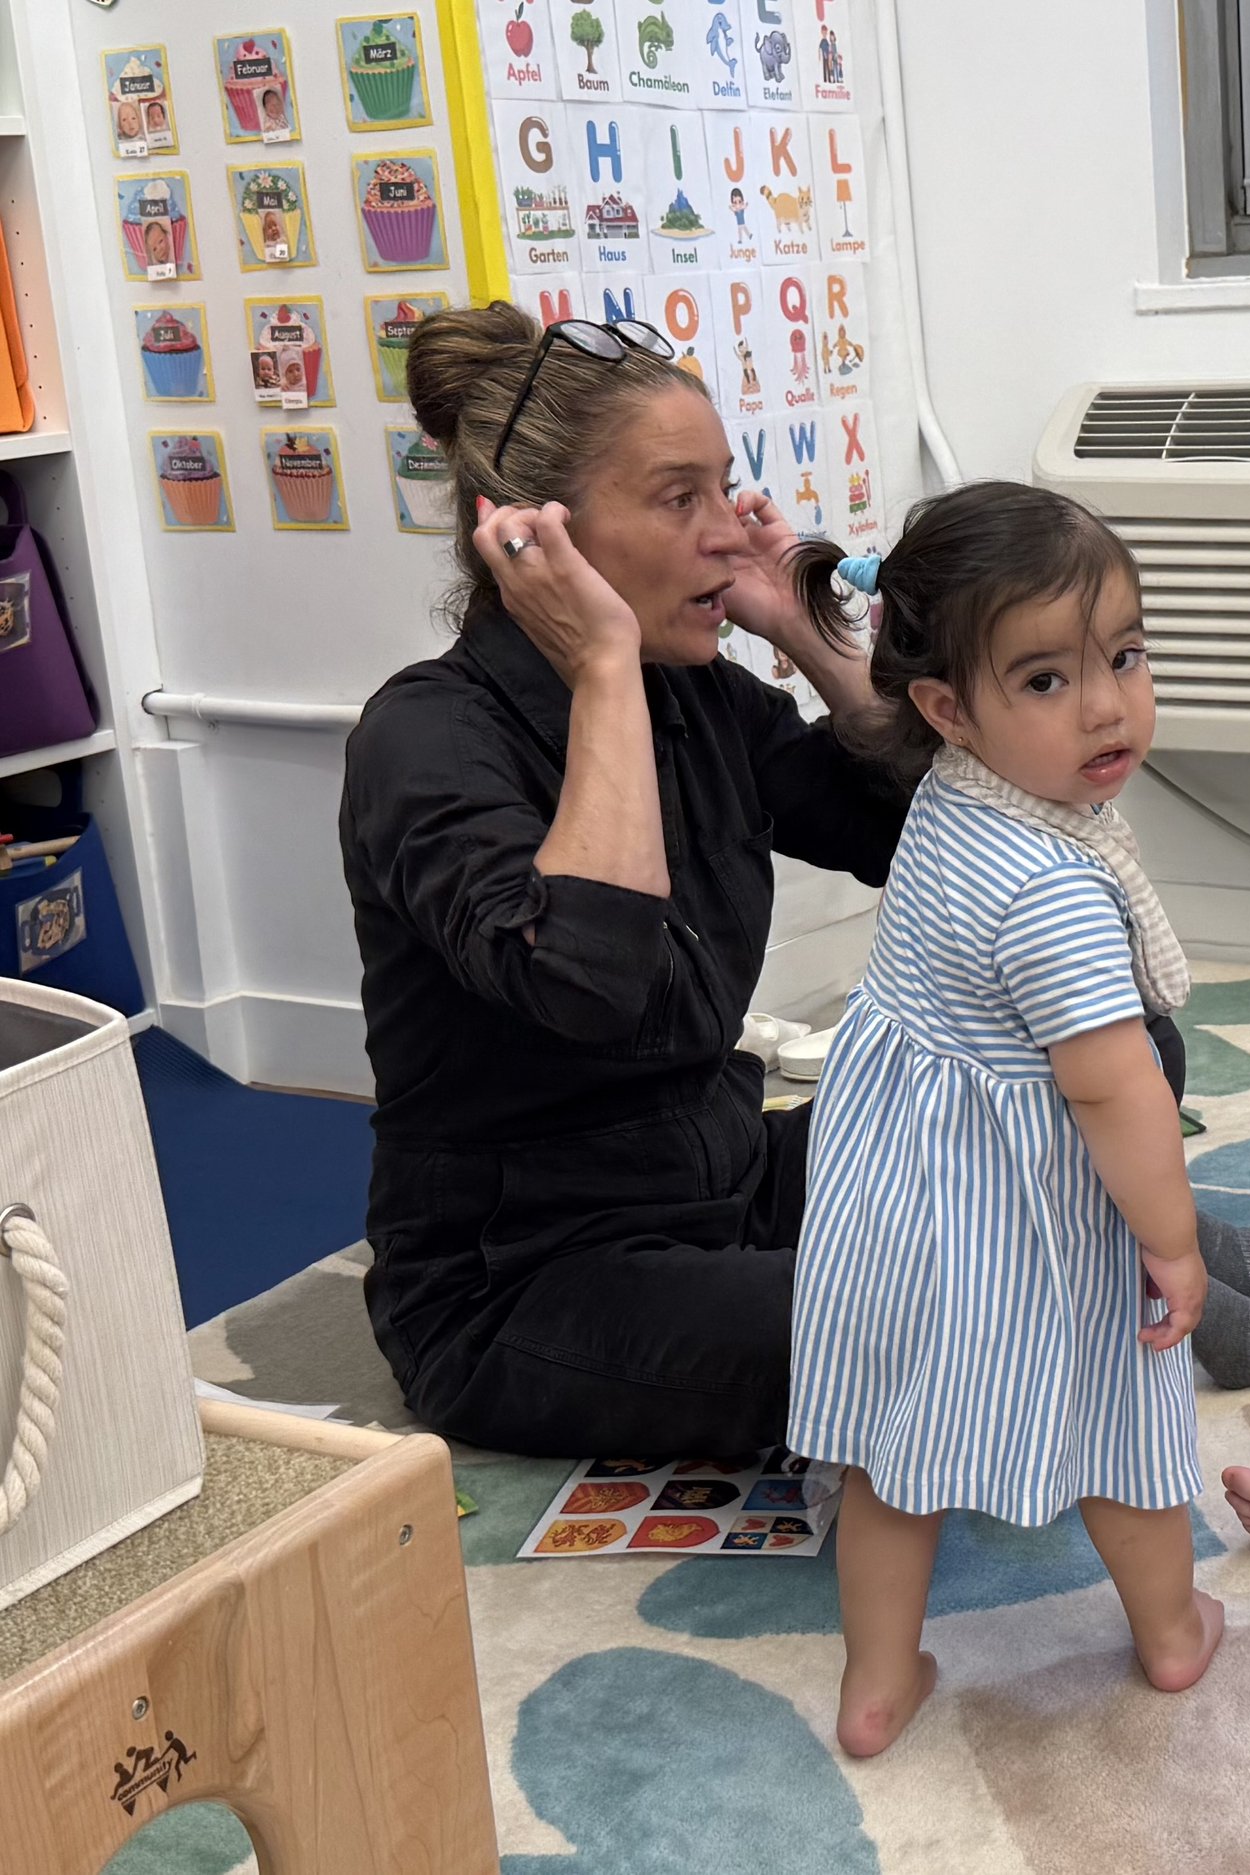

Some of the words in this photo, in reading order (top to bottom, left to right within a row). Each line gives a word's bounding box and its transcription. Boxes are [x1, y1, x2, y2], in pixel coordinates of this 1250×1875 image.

[237, 64, 268, 75] Februar
[507, 63, 542, 84] Apfel
[578, 73, 609, 92] Baum
[629, 71, 690, 94] Chamäleon
[713, 81, 741, 98] Delfin
[763, 87, 793, 102] Elefant
[815, 84, 851, 101] Familie
[519, 115, 553, 174] G
[586, 119, 623, 184] H
[769, 127, 798, 177] K
[828, 128, 853, 174] L
[724, 126, 745, 183] J
[388, 185, 408, 199] Juni
[146, 202, 165, 215] April
[529, 248, 569, 264] Garten
[599, 246, 627, 263] Haus
[672, 248, 698, 264] Insel
[729, 244, 757, 261] Junge
[774, 239, 808, 256] Katze
[831, 238, 866, 255] Lampe
[780, 276, 809, 325] Q
[827, 274, 849, 319] R
[665, 288, 699, 341] O
[730, 281, 752, 336] P
[159, 328, 175, 341] Juli
[739, 397, 763, 415] Papa
[789, 420, 816, 465] W
[841, 413, 865, 465] X
[742, 428, 766, 481] V
